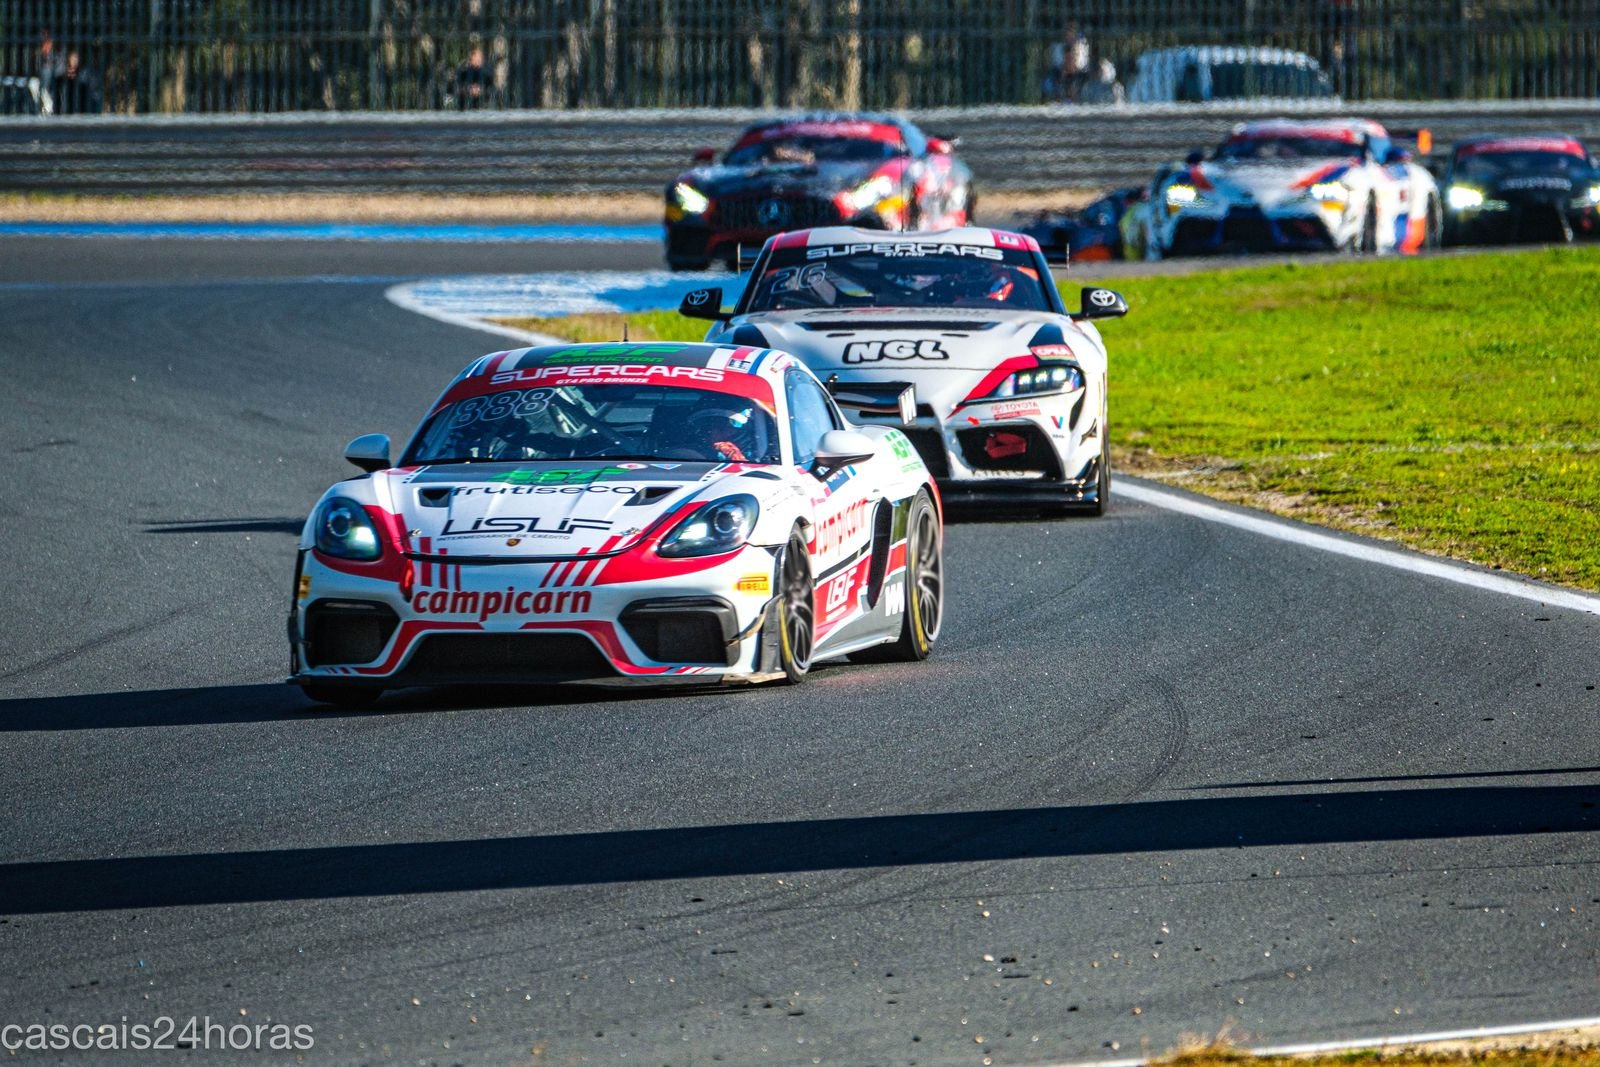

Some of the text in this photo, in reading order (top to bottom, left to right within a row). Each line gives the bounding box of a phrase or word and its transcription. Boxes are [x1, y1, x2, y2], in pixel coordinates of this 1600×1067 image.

[807, 243, 1004, 261] SUPERCARS
[771, 262, 827, 294] 26
[842, 339, 950, 364] NGL
[489, 364, 725, 385] SUPERCARS
[448, 387, 556, 429] 888
[1005, 401, 1039, 411] TOYOTA
[451, 485, 638, 497] frutiseca
[412, 586, 592, 622] campicarn
